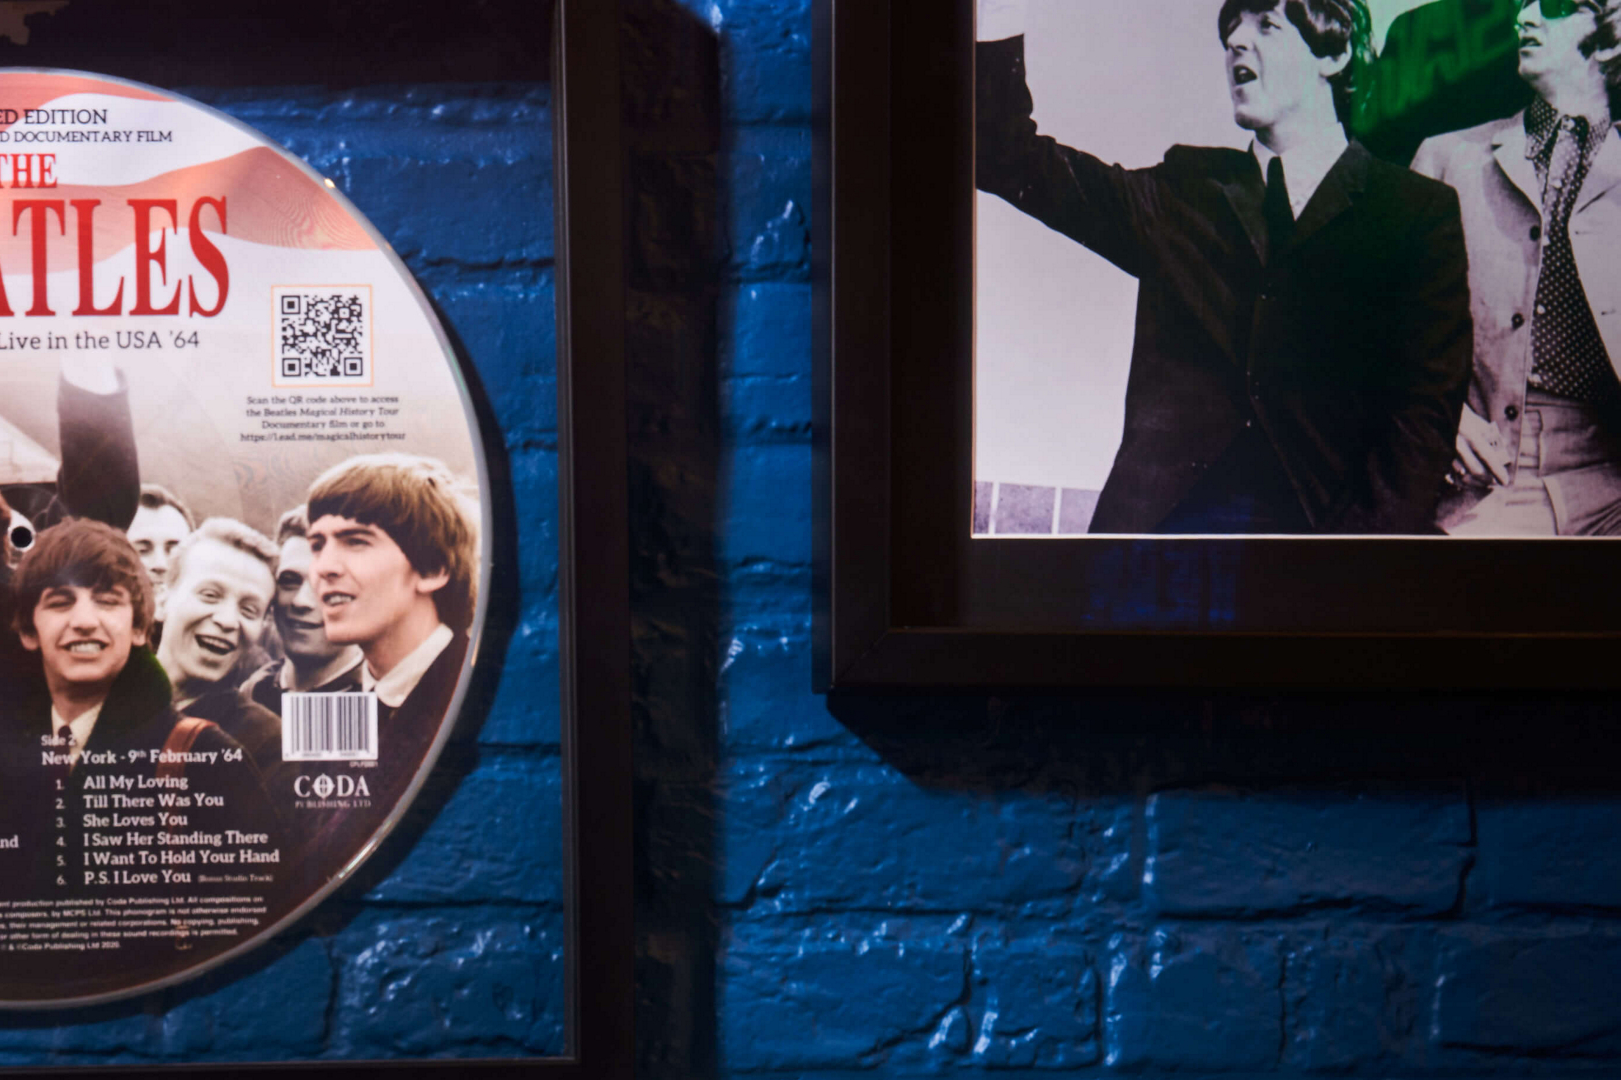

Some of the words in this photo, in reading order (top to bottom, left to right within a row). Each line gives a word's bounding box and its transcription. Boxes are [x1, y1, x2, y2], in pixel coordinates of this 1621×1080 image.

[24, 109, 108, 124] EDITION
[14, 130, 133, 143] DOCUMENTARY
[137, 130, 173, 142] FILM
[47, 332, 68, 349] in
[74, 331, 110, 349] the
[116, 331, 162, 349] USA
[246, 396, 269, 405] Scan
[271, 396, 287, 405] the
[289, 395, 303, 405] QR
[306, 395, 327, 404] code
[329, 395, 357, 404] above
[246, 408, 261, 417] the
[264, 408, 297, 417] Beatles
[299, 407, 337, 418] Magical
[339, 407, 375, 417] History
[378, 407, 399, 415] Tour
[261, 420, 325, 430] Documentary
[329, 420, 348, 428] film
[362, 421, 373, 429] go
[375, 420, 385, 428] to
[41, 735, 66, 747] Side
[69, 735, 76, 746] 2
[41, 751, 76, 766] New
[80, 750, 117, 765] York
[150, 749, 218, 765] February
[83, 776, 106, 790] All
[109, 775, 135, 792] My
[137, 775, 189, 791] Loving
[293, 773, 370, 799] CODA
[83, 795, 108, 809] Till
[111, 794, 154, 808] There
[158, 793, 191, 807] Was
[194, 793, 224, 806] You
[83, 814, 110, 828] She
[112, 813, 155, 827] Loves
[158, 812, 188, 827] You
[83, 833, 90, 847] I
[91, 833, 123, 846] Saw
[126, 832, 154, 846] Her
[157, 831, 222, 847] Standing
[224, 830, 269, 844] There
[83, 852, 90, 865] I
[92, 851, 135, 865] Want
[138, 851, 157, 865] To
[160, 850, 196, 864] Hold
[199, 850, 237, 864] Your
[239, 849, 280, 863] Hand
[84, 871, 111, 885] P.S.
[114, 871, 120, 884] I
[122, 870, 159, 884] Love
[161, 870, 192, 883] You
